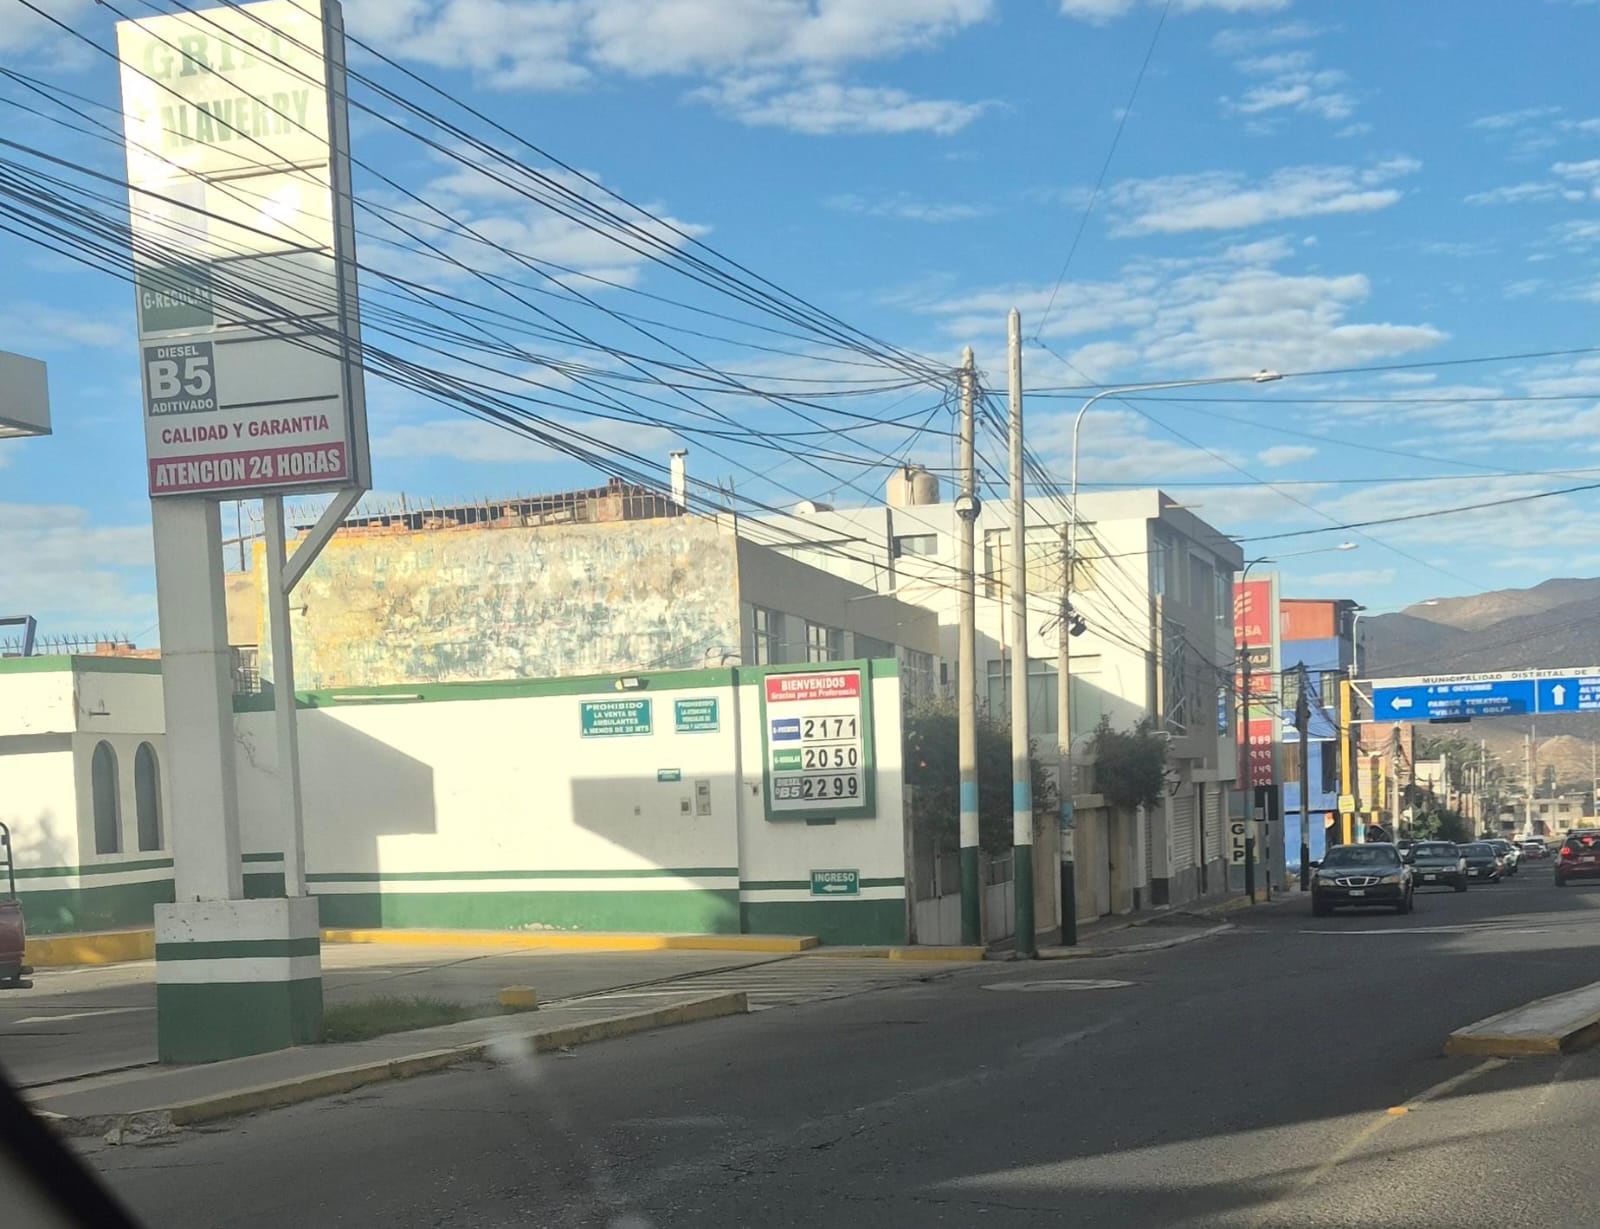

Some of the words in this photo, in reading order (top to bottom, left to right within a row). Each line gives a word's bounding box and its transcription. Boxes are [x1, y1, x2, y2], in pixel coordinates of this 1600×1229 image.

[157, 345, 199, 358] DIESEL
[149, 356, 212, 401] B5
[151, 398, 214, 414] ADITIVADO
[162, 422, 228, 444] CALIDAD
[233, 423, 243, 438] Y
[249, 414, 329, 437] GARANTIA
[156, 457, 245, 487] ATENCION
[250, 455, 273, 479] 24
[276, 448, 341, 476] HORAS
[781, 676, 846, 692] BIENVENIDOS
[1423, 673, 1503, 684] MUNICIPALIDAD
[1511, 668, 1564, 679] DISTRITAL
[586, 702, 644, 711] PROHIBIDO
[804, 718, 856, 739] 2171
[804, 747, 857, 769] 2050
[803, 776, 857, 798] 2299
[1231, 823, 1245, 862] GLP
[814, 872, 855, 883] INGRESO
